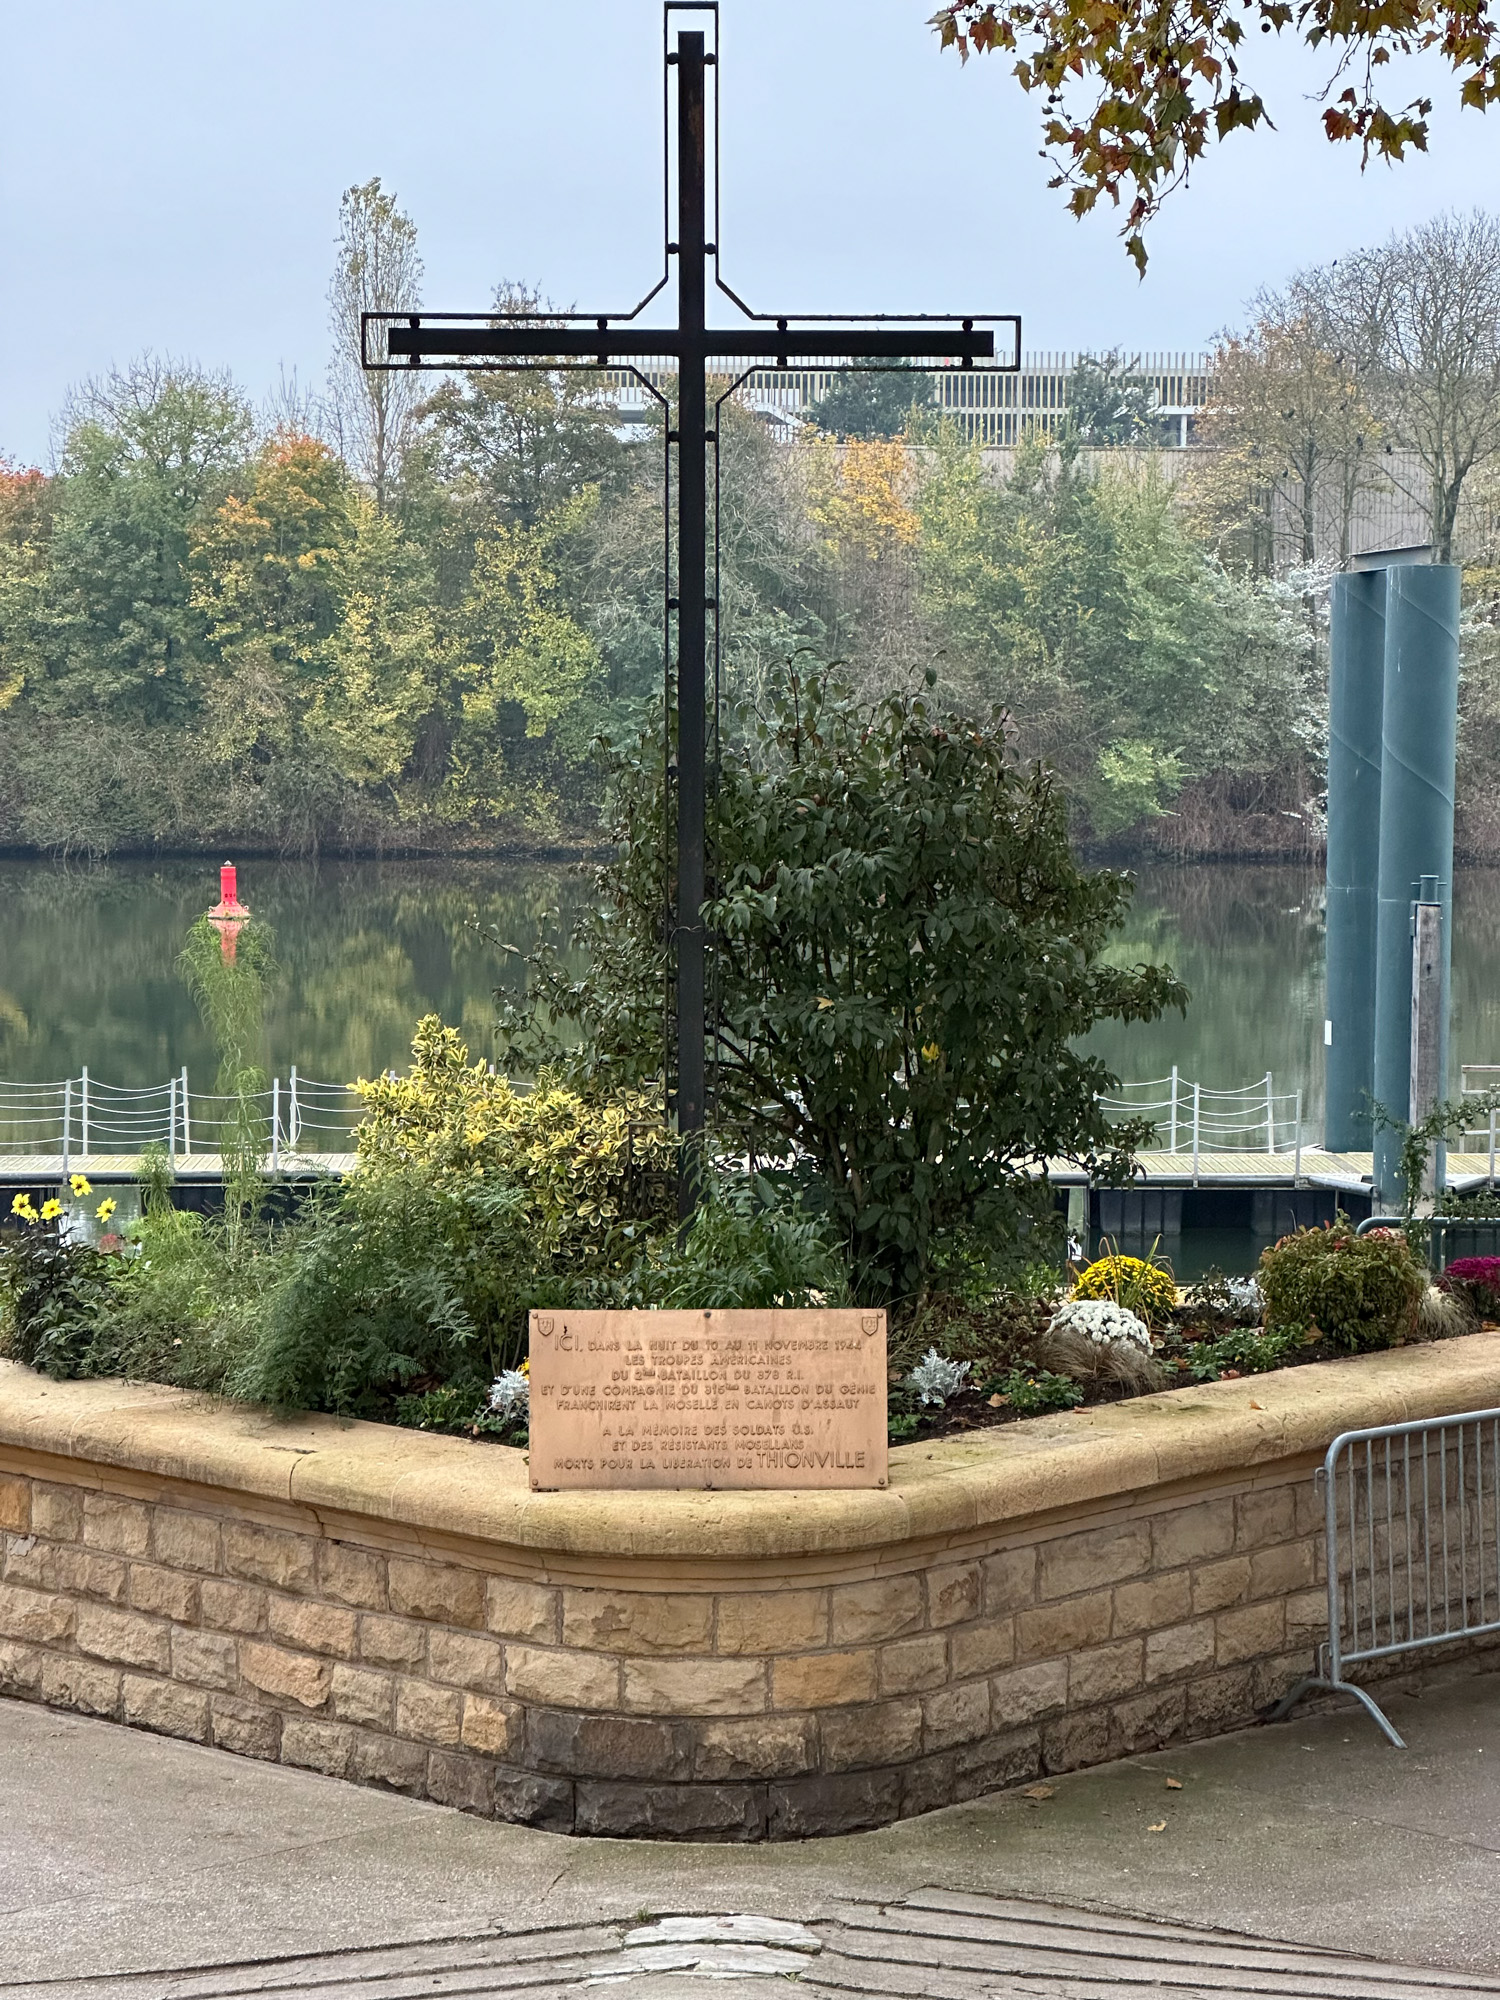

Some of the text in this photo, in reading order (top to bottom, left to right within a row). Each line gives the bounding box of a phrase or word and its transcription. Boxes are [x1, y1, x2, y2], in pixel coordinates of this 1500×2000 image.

[588, 1341, 620, 1350] DANS
[627, 1341, 643, 1350] LA
[649, 1340, 677, 1350] NUIT
[682, 1340, 699, 1350] DU
[706, 1340, 718, 1350] 10
[725, 1340, 741, 1350] AU
[748, 1340, 757, 1350] 11
[764, 1340, 829, 1350] NOVEMBRE
[835, 1340, 862, 1350] 1944
[625, 1355, 645, 1366] LES
[651, 1355, 704, 1365] TROUPES
[612, 1370, 629, 1381] DU
[660, 1369, 727, 1381] BATAILLON
[734, 1370, 750, 1380] DU
[541, 1385, 555, 1396] ET
[602, 1385, 675, 1396] COMPAGNIE
[681, 1385, 698, 1395] DU
[744, 1385, 809, 1395] BATAILLON
[815, 1385, 833, 1395] DU
[556, 1400, 636, 1411] FRANCHIRENT
[643, 1400, 659, 1410] LA
[665, 1400, 718, 1410] MOSELLE
[725, 1400, 739, 1410] EN
[746, 1400, 795, 1410] CANOTS
[618, 1426, 634, 1436] LA
[704, 1425, 727, 1436] DES
[733, 1425, 786, 1436] SOLDATS
[612, 1441, 627, 1451] ET
[632, 1440, 653, 1451] DES
[734, 1440, 805, 1450] MOSELLANS
[553, 1458, 594, 1470] MORTS
[600, 1458, 633, 1469] POUR
[640, 1458, 656, 1469] LA
[737, 1458, 752, 1469] DE
[757, 1451, 866, 1469] THIONVILLE
